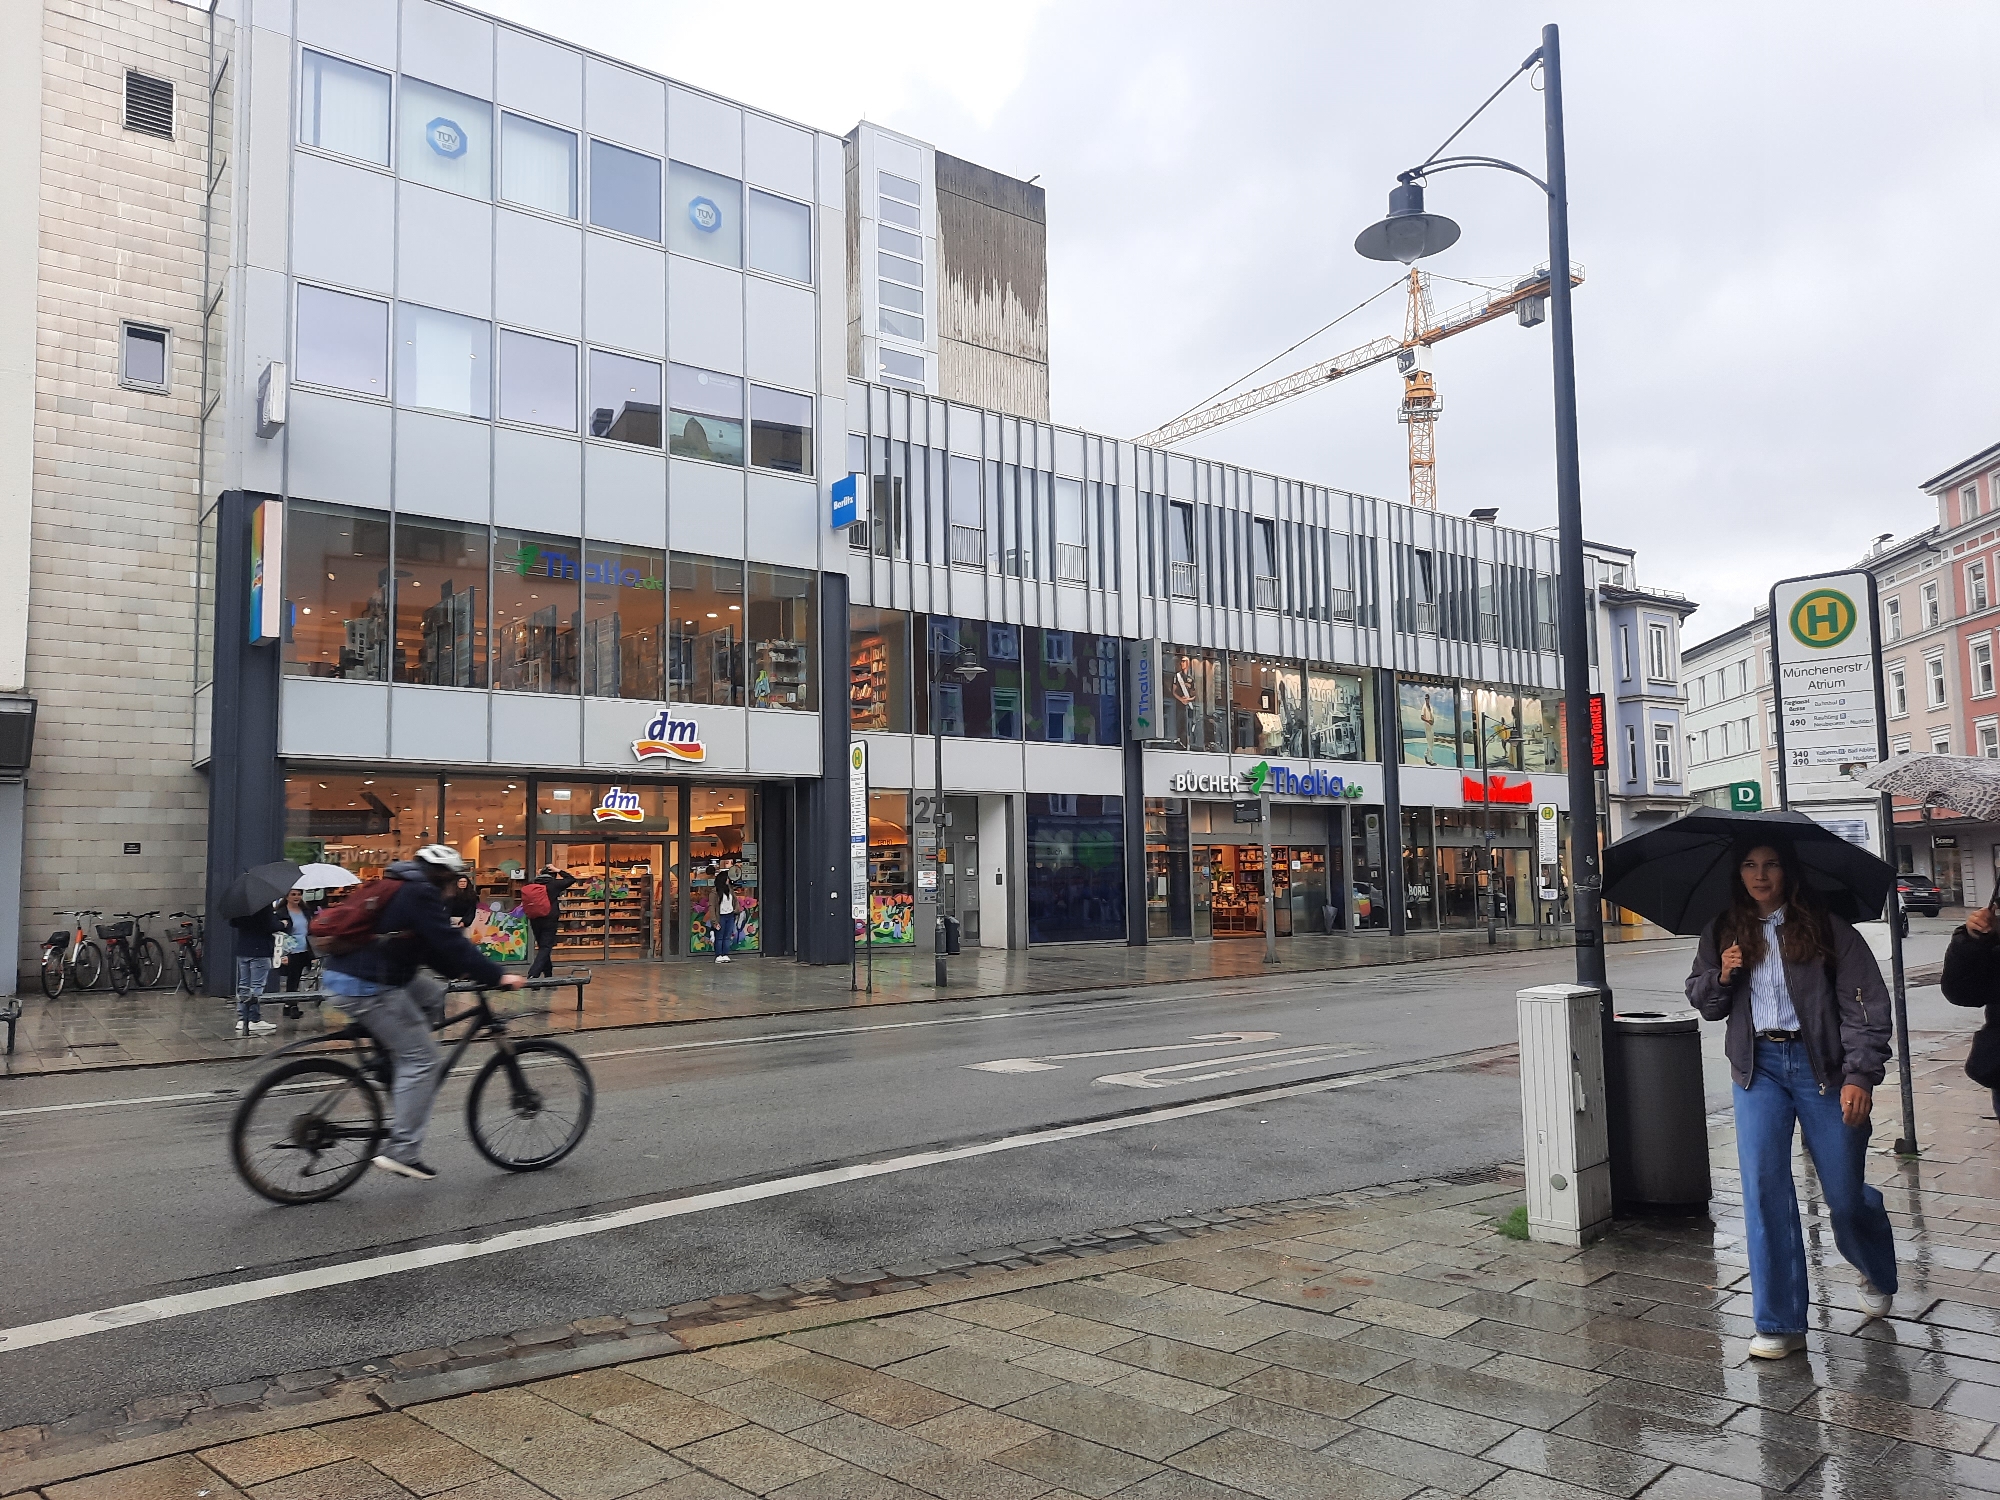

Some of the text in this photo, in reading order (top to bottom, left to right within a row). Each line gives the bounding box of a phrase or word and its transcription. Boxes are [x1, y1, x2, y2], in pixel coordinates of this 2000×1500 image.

[833, 495, 854, 511] Berlitz
[1807, 602, 1838, 636] H
[1783, 661, 1871, 678] Münchenerstr./
[1808, 679, 1846, 690] Atrium
[648, 711, 697, 742] dm
[1789, 718, 1806, 726] 490
[1792, 750, 1809, 758] 340
[1792, 758, 1809, 766] 490
[1176, 766, 1364, 798] BÜCHER Thalia.de
[604, 789, 637, 809] dm
[1737, 787, 1754, 802] D
[1408, 885, 1429, 897] BORA!
